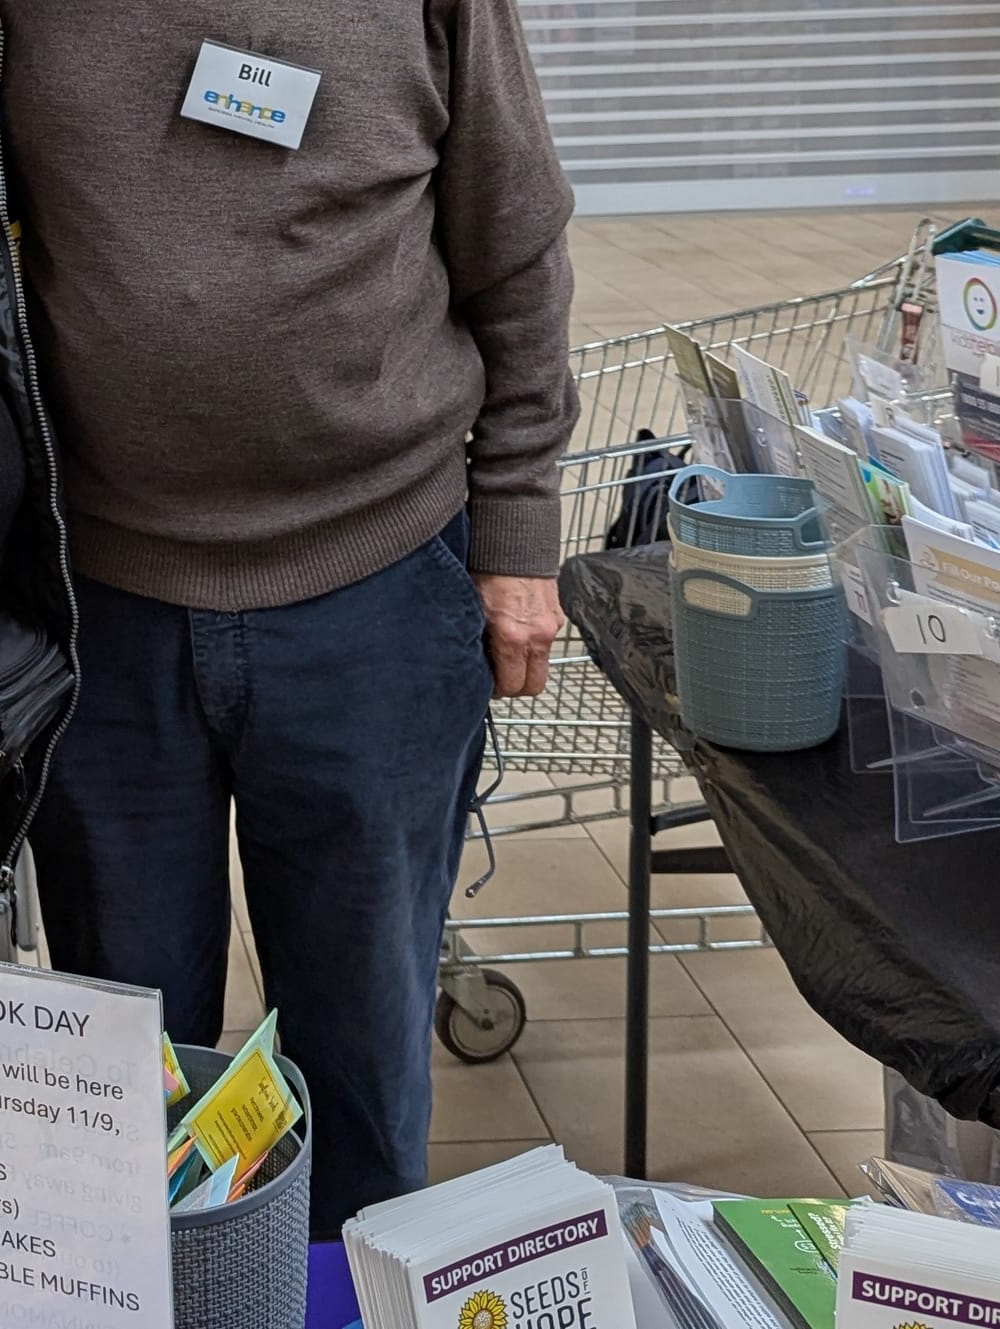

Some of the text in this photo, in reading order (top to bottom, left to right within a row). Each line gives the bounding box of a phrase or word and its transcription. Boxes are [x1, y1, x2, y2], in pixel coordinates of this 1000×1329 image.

[238, 63, 272, 88] Bill
[203, 89, 286, 123] enhance
[916, 614, 946, 644] 10
[34, 1005, 90, 1037] DAY
[2, 1063, 39, 1084] will
[44, 1068, 69, 1089] be
[76, 1074, 124, 1101] here
[67, 1106, 120, 1136] 11/9,
[431, 1218, 599, 1295] SUPPORT DIRECTORY
[40, 1271, 141, 1311] MUFFINS
[510, 1271, 580, 1319] SEEDS
[861, 1279, 963, 1317] SUPPORT
